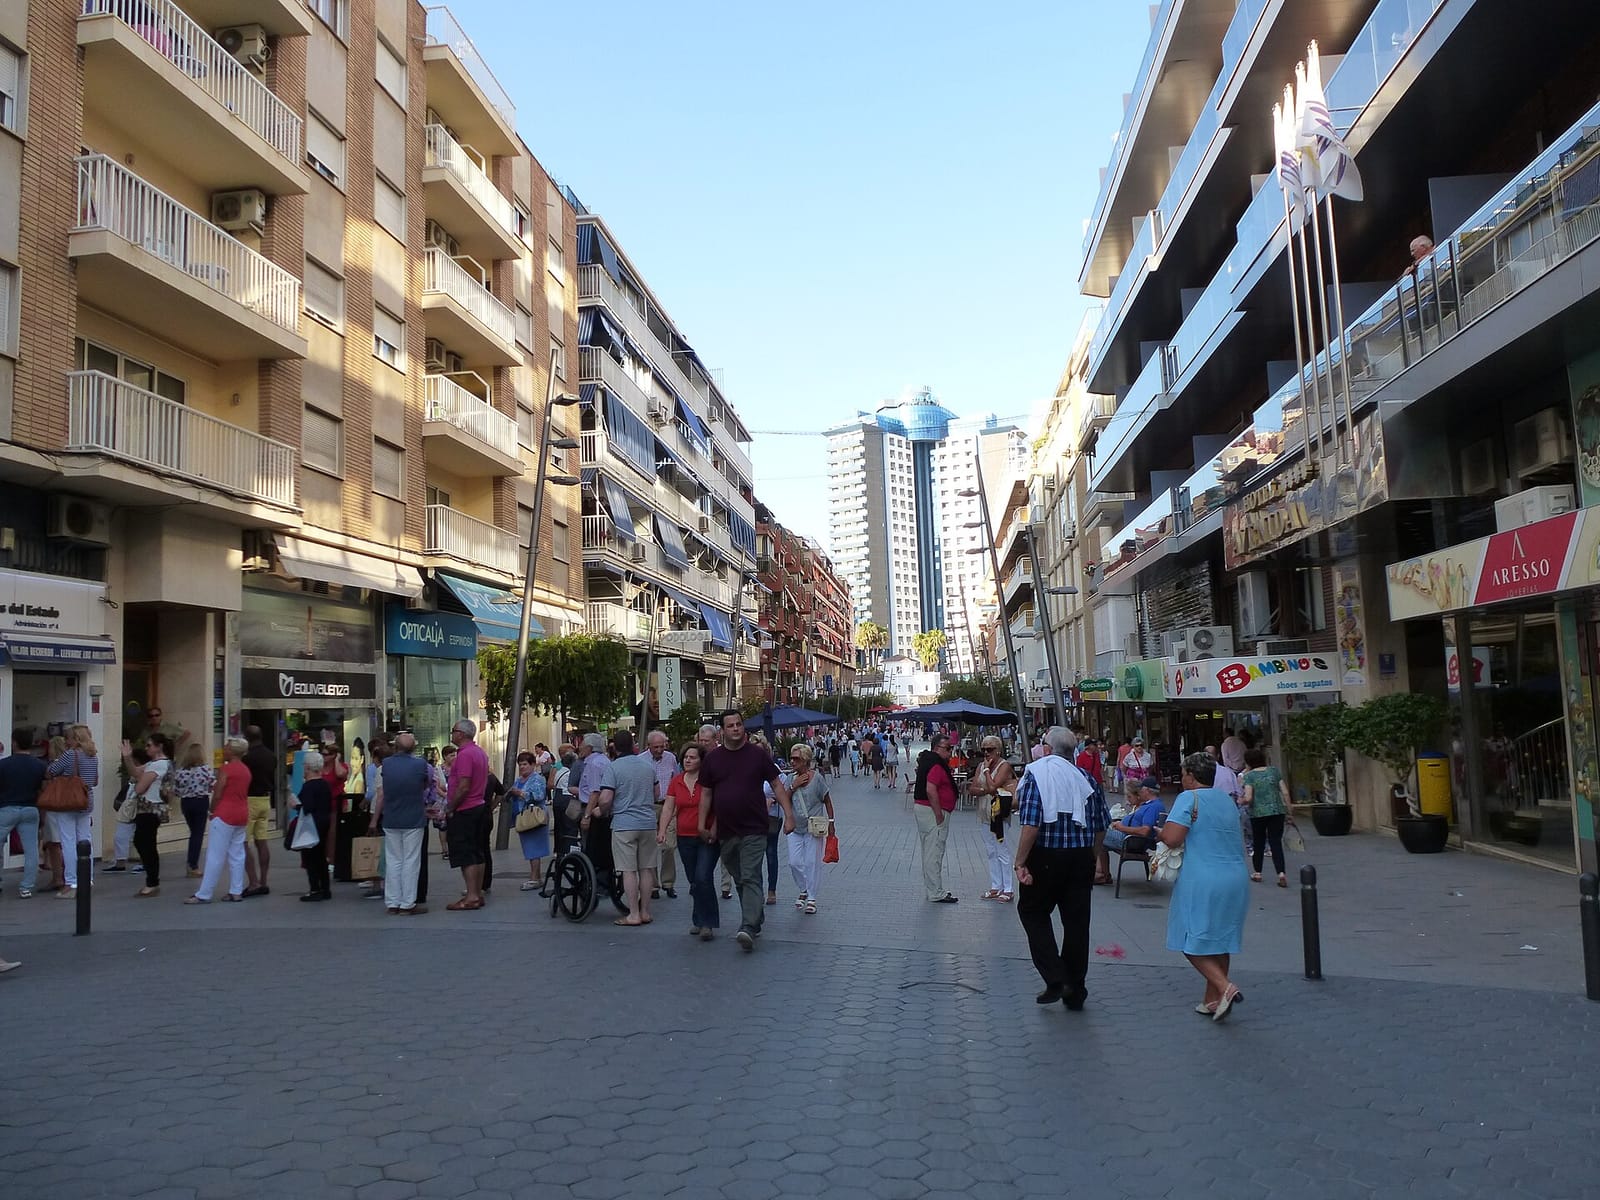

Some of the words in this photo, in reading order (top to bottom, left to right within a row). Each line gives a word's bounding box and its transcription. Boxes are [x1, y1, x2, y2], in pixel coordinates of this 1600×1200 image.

[1492, 558, 1550, 586] ARESSO
[9, 603, 24, 615] del
[26, 605, 59, 618] Estado
[449, 634, 473, 646] ESPINOSA
[665, 658, 674, 706] BOSTON
[1080, 681, 1111, 690] Specsavers
[1276, 681, 1298, 690] shoes
[1303, 679, 1333, 689] zapatos
